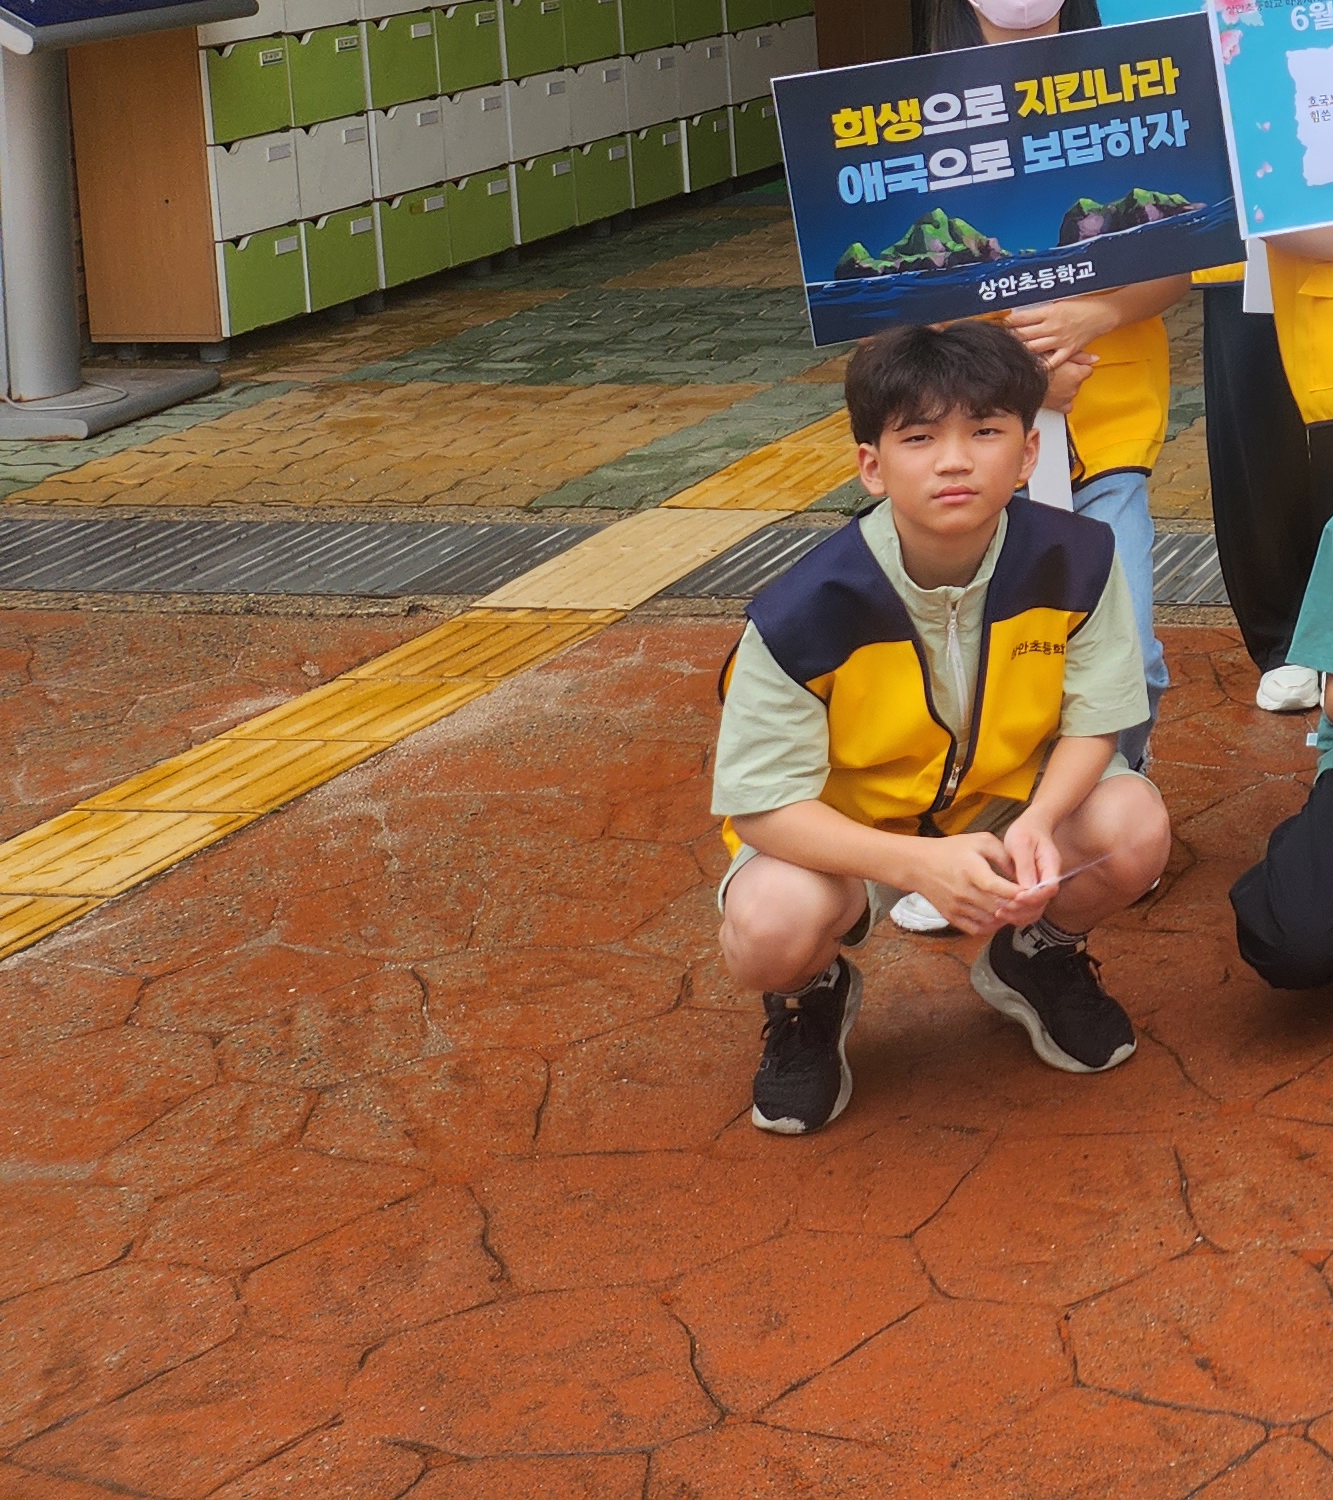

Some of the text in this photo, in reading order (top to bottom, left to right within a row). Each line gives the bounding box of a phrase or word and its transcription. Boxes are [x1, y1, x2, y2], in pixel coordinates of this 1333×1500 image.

[831, 56, 1180, 149] 희생으로 지킨나라
[1309, 109, 1331, 123] 힘쓴
[838, 108, 1191, 206] 애국으로 보답하자
[977, 261, 1096, 303] 상안초등학교
